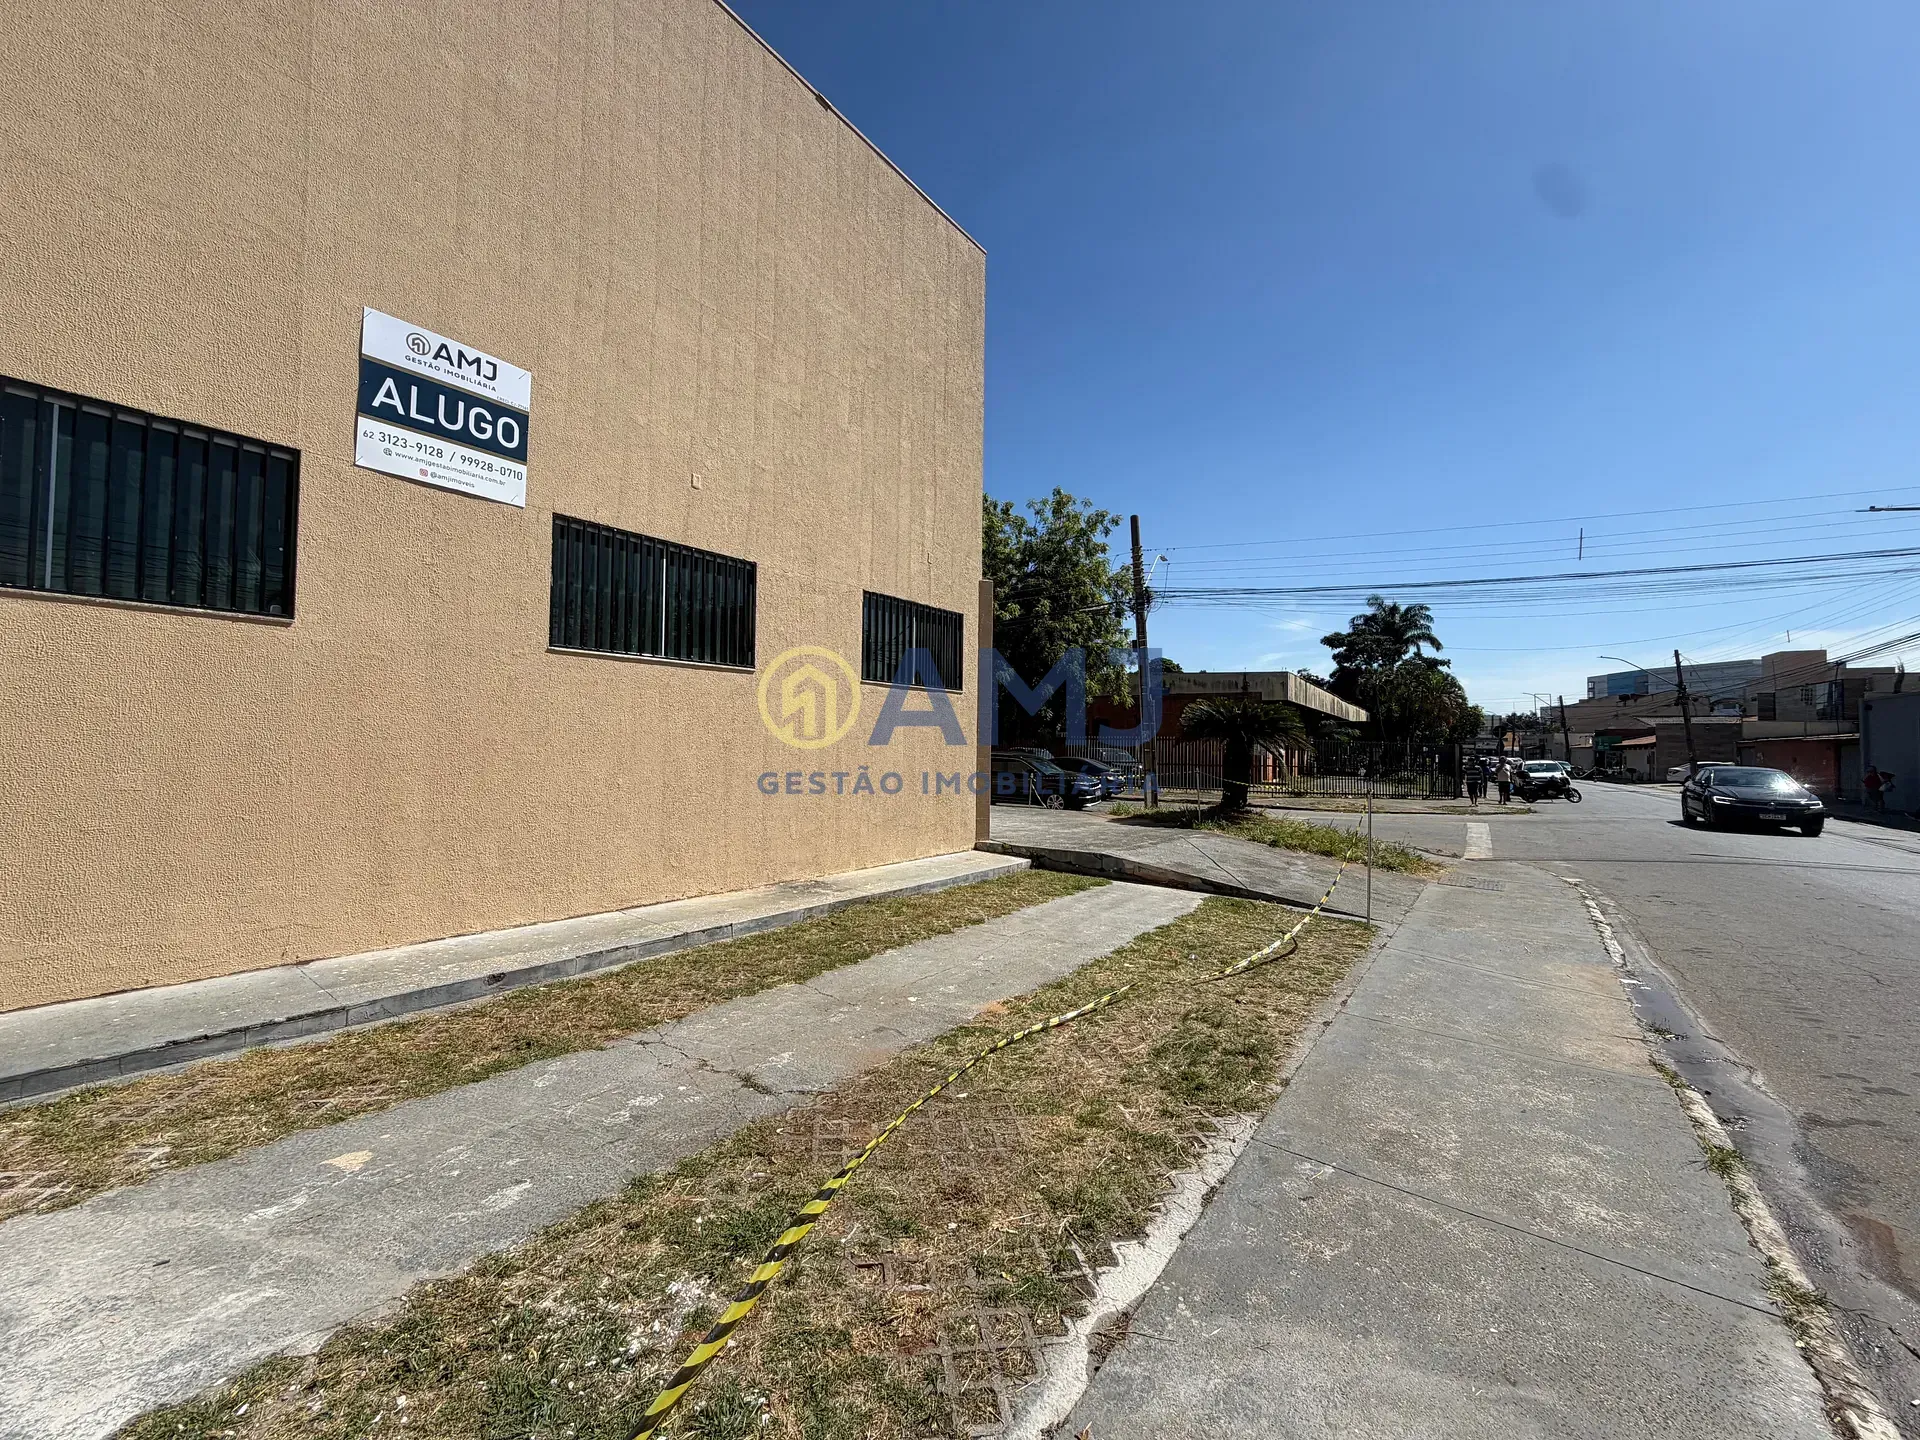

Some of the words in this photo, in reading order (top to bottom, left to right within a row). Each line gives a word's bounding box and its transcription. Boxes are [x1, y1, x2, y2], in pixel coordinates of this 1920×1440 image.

[404, 355, 440, 372] GESTÃO
[443, 369, 497, 392] IMOBILIÁRIA
[432, 343, 499, 382] AMJ
[371, 377, 520, 449] ALUGO
[362, 430, 375, 440] 62
[378, 431, 444, 459] 3123-9128
[449, 451, 456, 463] /
[460, 455, 524, 481] 99928-0710
